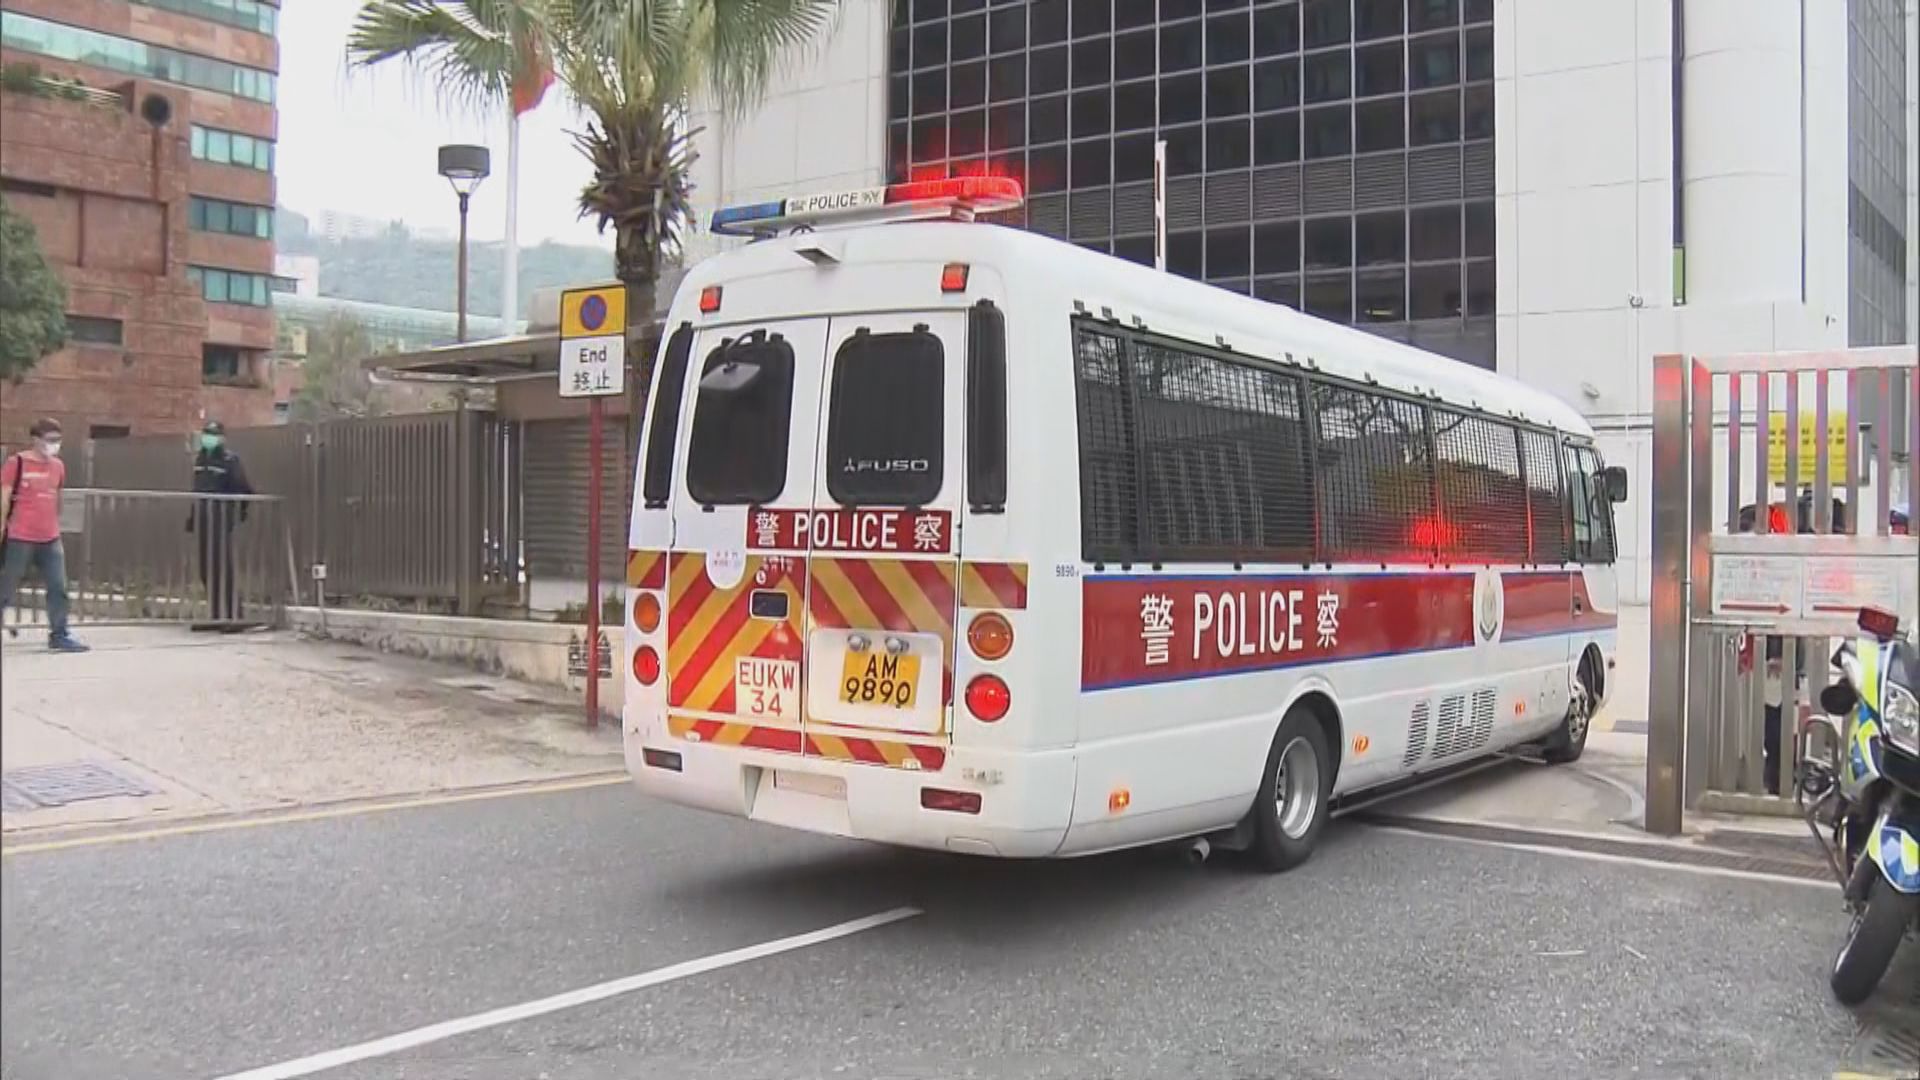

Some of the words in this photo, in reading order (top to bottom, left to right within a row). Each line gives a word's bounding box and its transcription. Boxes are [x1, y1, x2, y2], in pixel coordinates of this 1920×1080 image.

[809, 192, 859, 210] POLICE
[579, 346, 607, 363] End
[857, 459, 929, 471] FUSO
[755, 512, 780, 546] 警
[793, 512, 898, 549] POLICE
[913, 514, 942, 550] 察
[1140, 593, 1175, 666] 警
[1192, 589, 1304, 659] POLICE
[1316, 589, 1340, 648] 察
[739, 660, 795, 689] EUKW
[864, 654, 897, 679] AM
[750, 690, 782, 717] 34
[845, 677, 911, 704] 9890
